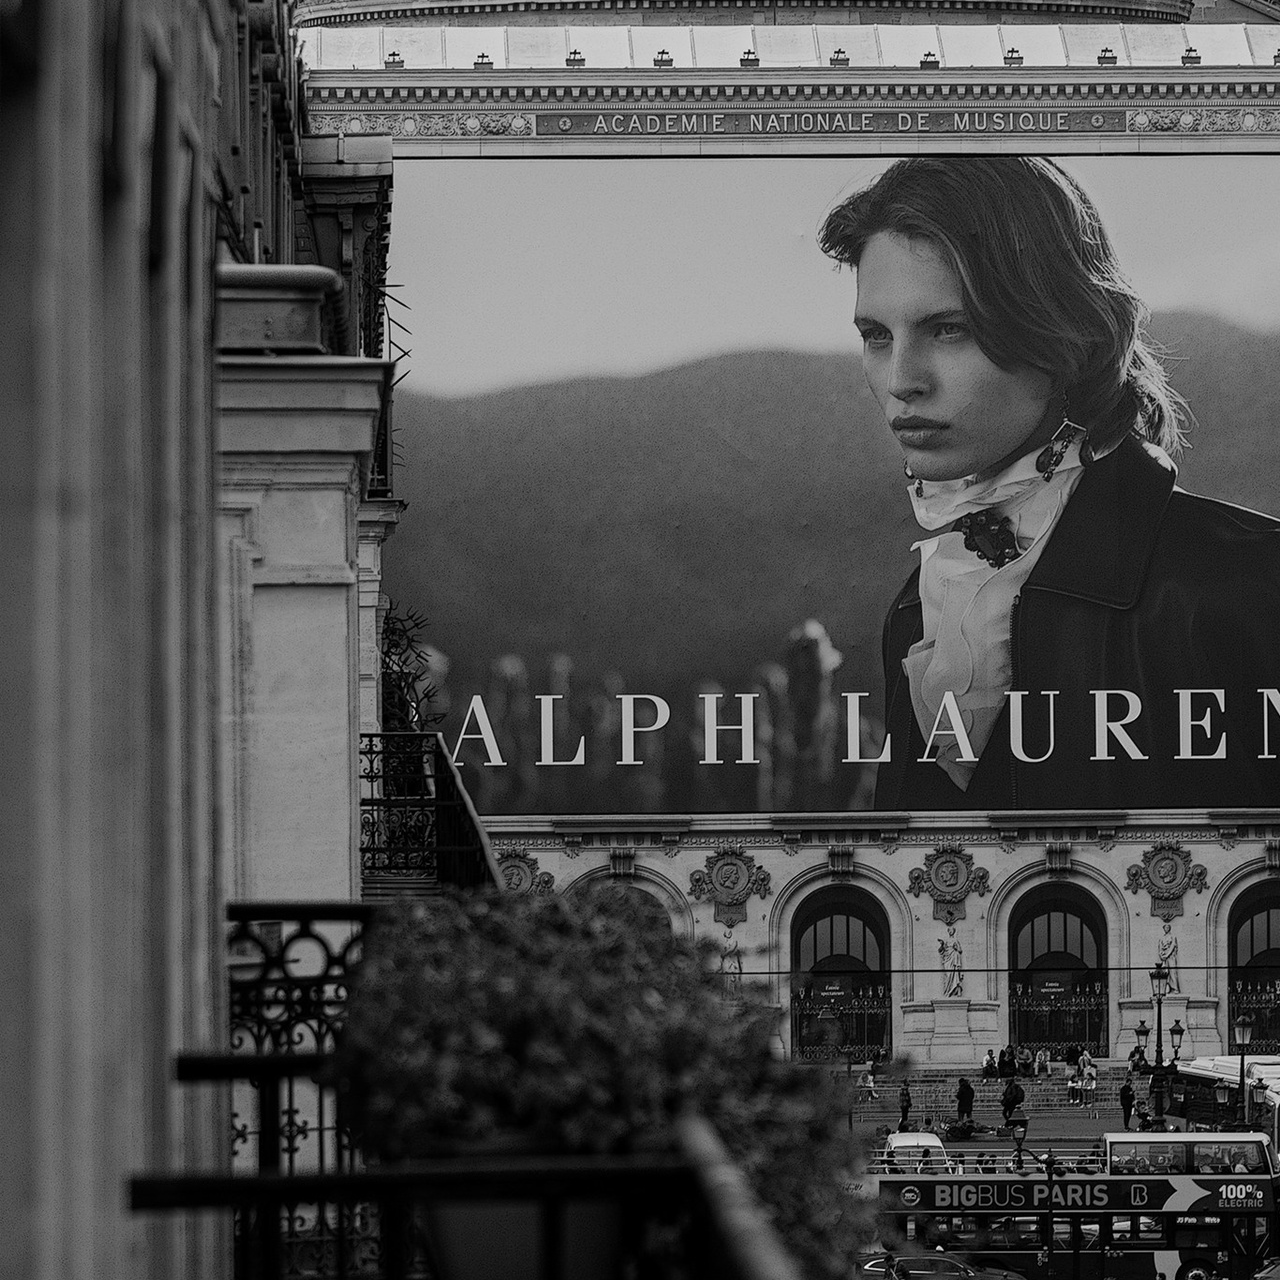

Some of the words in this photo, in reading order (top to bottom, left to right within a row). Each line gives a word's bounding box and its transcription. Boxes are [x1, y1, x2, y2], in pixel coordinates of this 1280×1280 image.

[593, 113, 726, 134] ACADEMIE
[749, 112, 875, 132] NATIONALE
[897, 111, 931, 132] DE
[952, 111, 1070, 132] MUSIQUE
[452, 692, 762, 767] ALPH
[935, 1184, 1025, 1207] BIGBUS
[1033, 1184, 1108, 1206] PARIS
[1218, 1184, 1263, 1198] 100%
[1218, 1199, 1263, 1208] ELECTRIC
